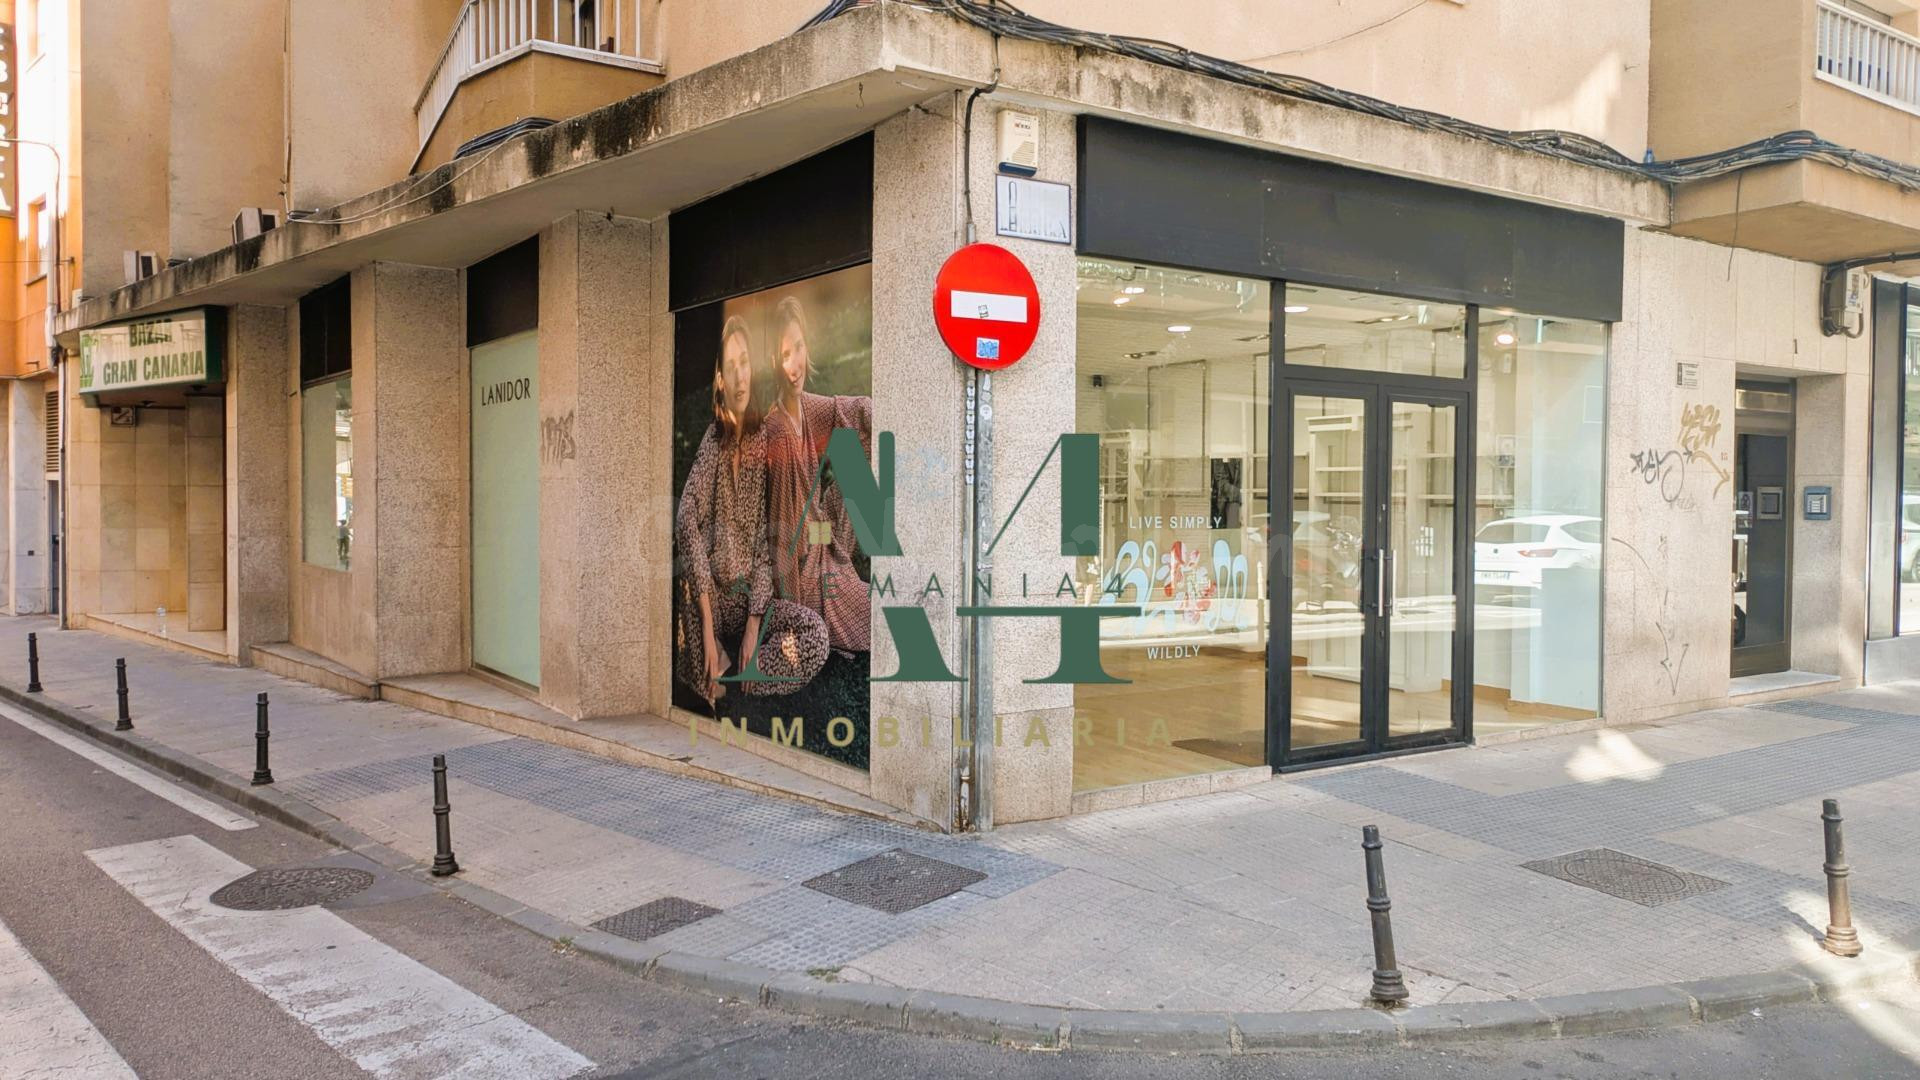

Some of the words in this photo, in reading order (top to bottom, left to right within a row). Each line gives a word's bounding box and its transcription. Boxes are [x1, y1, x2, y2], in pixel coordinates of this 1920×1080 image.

[103, 359, 137, 386] GRAN
[143, 350, 204, 380] CANARIA
[481, 378, 531, 407] LANIDOR
[1129, 516, 1163, 529] LIVE
[1169, 516, 1222, 529] SIMPLY
[1147, 644, 1201, 660] WILDLY
